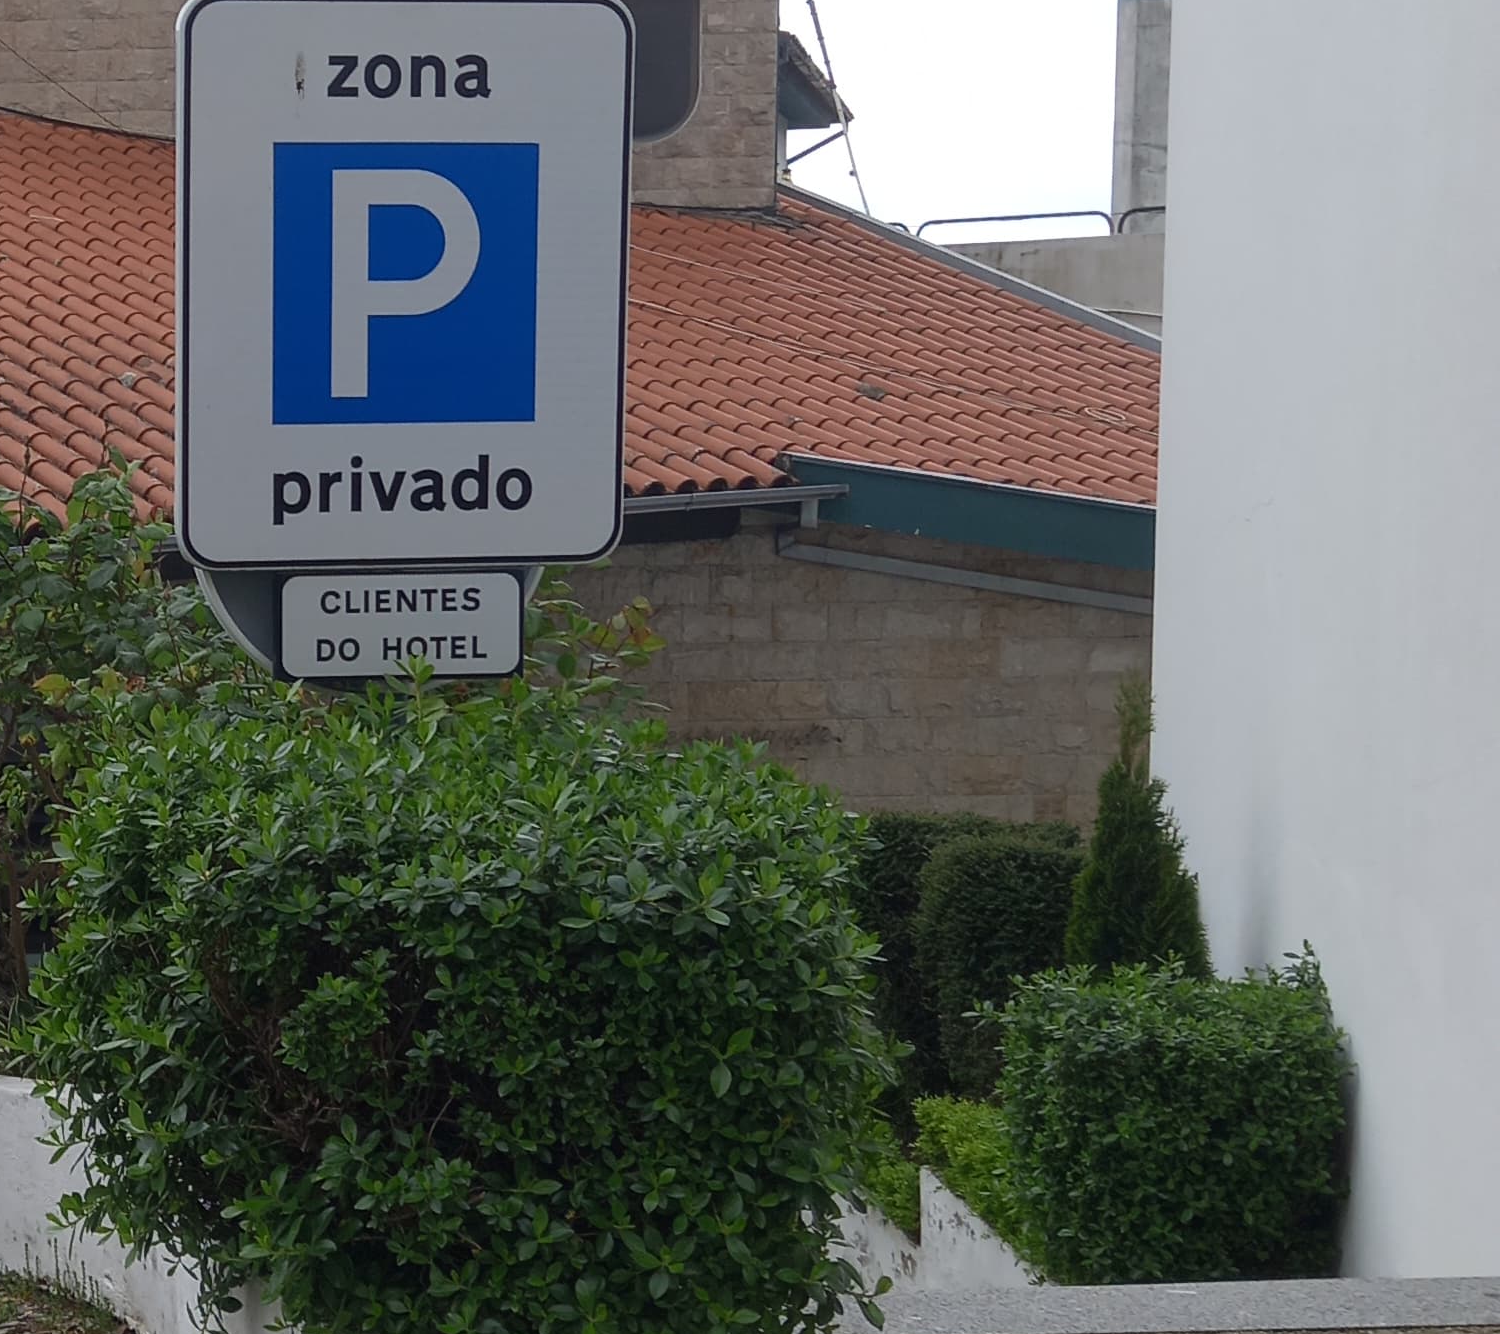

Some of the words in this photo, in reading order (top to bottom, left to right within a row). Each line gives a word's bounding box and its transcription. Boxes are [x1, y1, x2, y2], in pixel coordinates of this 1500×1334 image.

[327, 54, 492, 99] zona
[330, 168, 481, 398] P
[273, 454, 533, 526] privado
[319, 587, 482, 615] CLIENTES
[315, 637, 361, 662] DO
[382, 635, 488, 661] HOTEL
